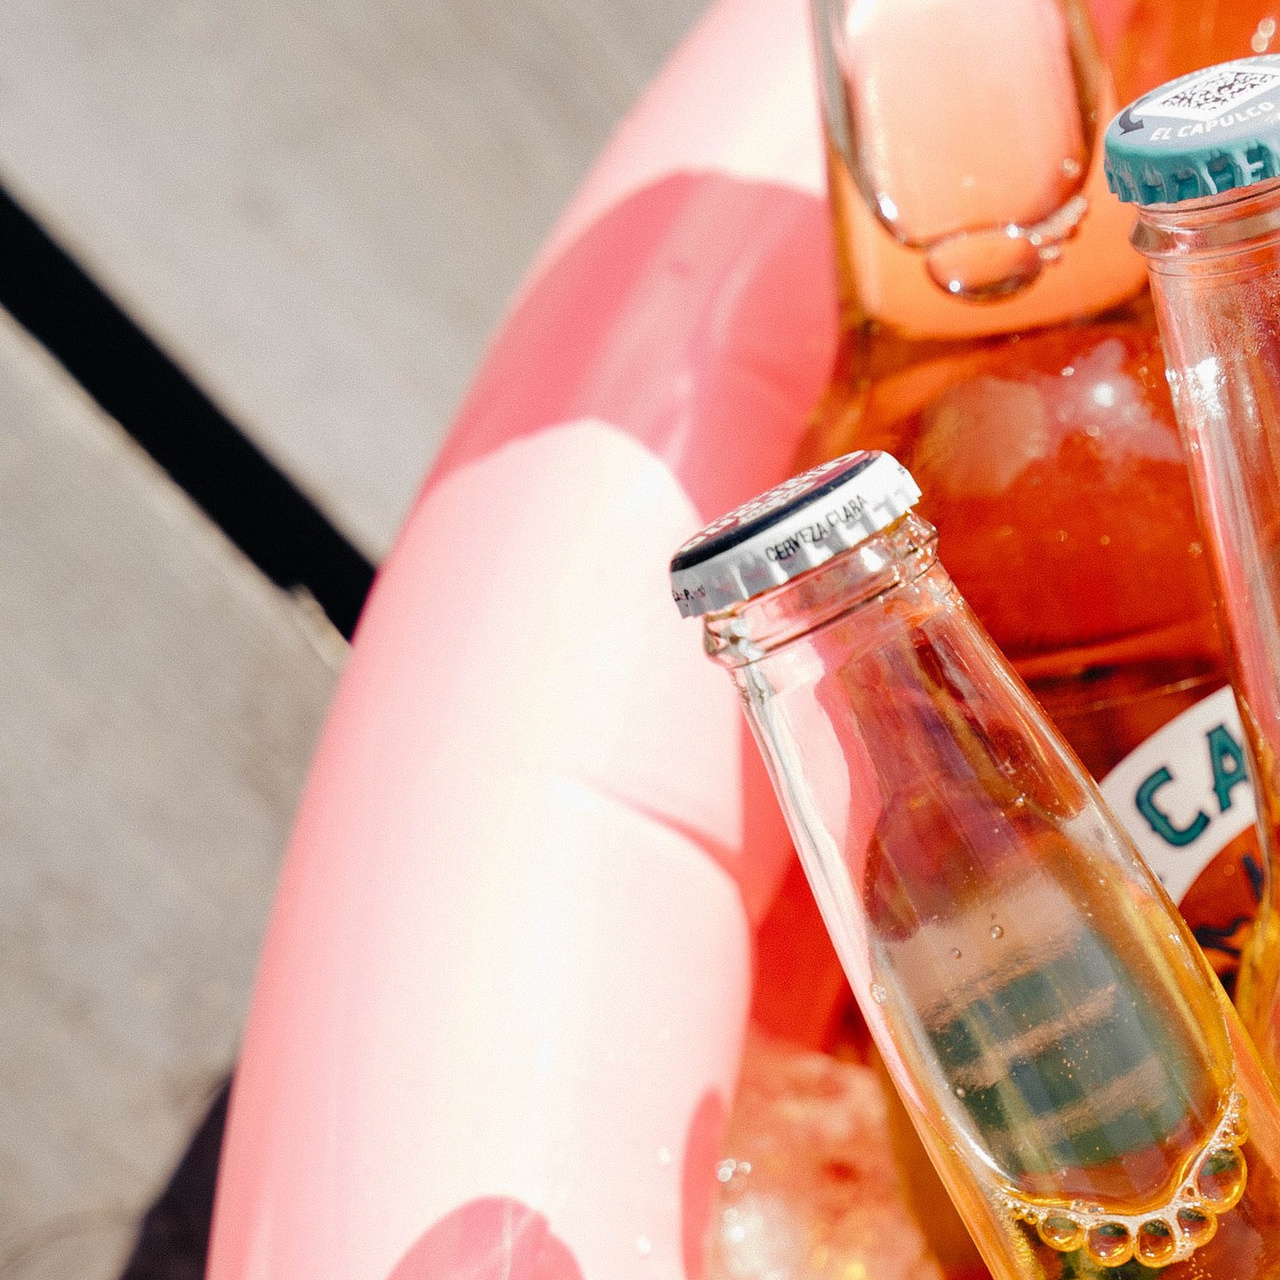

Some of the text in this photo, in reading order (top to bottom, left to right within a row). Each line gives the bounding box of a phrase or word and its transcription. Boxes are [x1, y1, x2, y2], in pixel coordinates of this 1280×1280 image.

[1150, 101, 1276, 142] EL CAPULCO
[765, 494, 869, 561] CERVEZA CLARA
